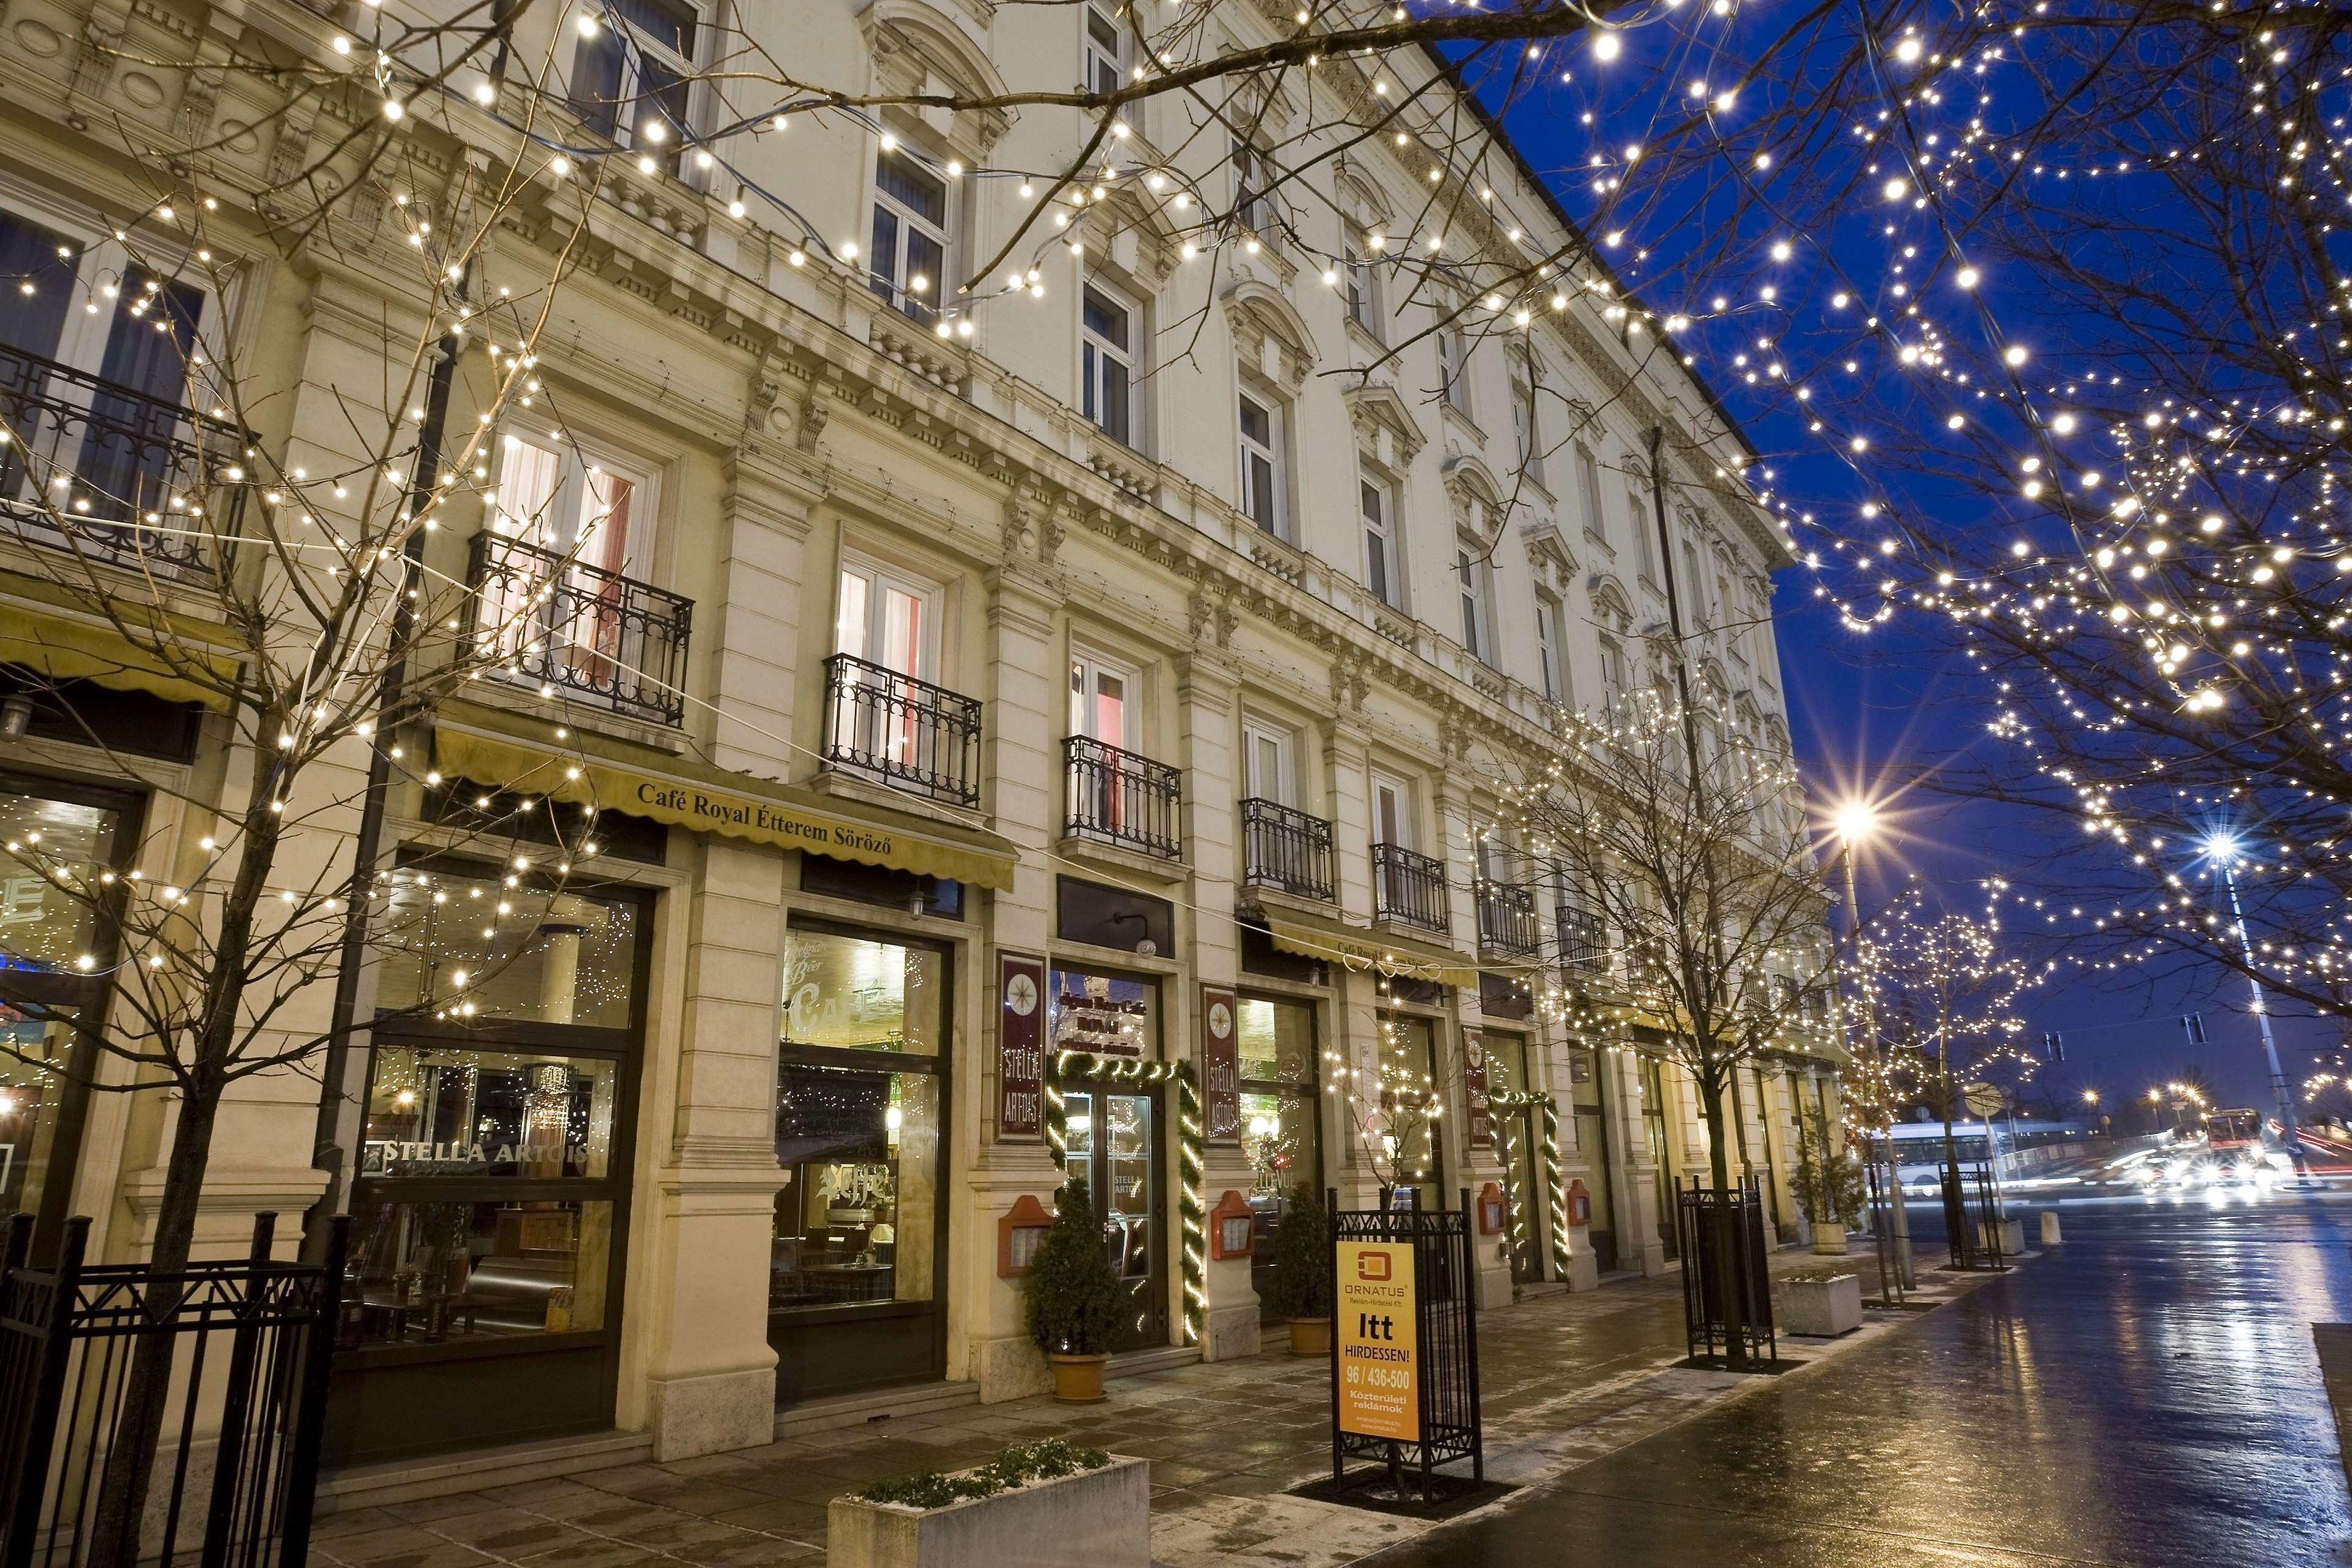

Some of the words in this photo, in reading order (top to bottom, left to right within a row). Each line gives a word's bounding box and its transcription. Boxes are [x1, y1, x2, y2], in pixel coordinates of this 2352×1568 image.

[637, 783, 686, 811] Café
[693, 794, 750, 825] Royal
[757, 804, 828, 842] Étterem
[833, 826, 892, 855] Söröző
[1005, 1048, 1039, 1080] STELLA
[1210, 1066, 1235, 1093] STELLA
[1004, 1092, 1037, 1123] ARTOIS
[384, 1139, 486, 1162] STELLA
[494, 1144, 588, 1164] ARTOIS
[1345, 1285, 1405, 1297] ORNATUS
[1359, 1312, 1393, 1341] Itt
[1345, 1344, 1410, 1363] HIRDESSEN!
[1347, 1365, 1360, 1384] 96
[1368, 1368, 1410, 1390] 436-500
[1350, 1390, 1407, 1405] Közterületi
[1354, 1401, 1403, 1413] reklámok
